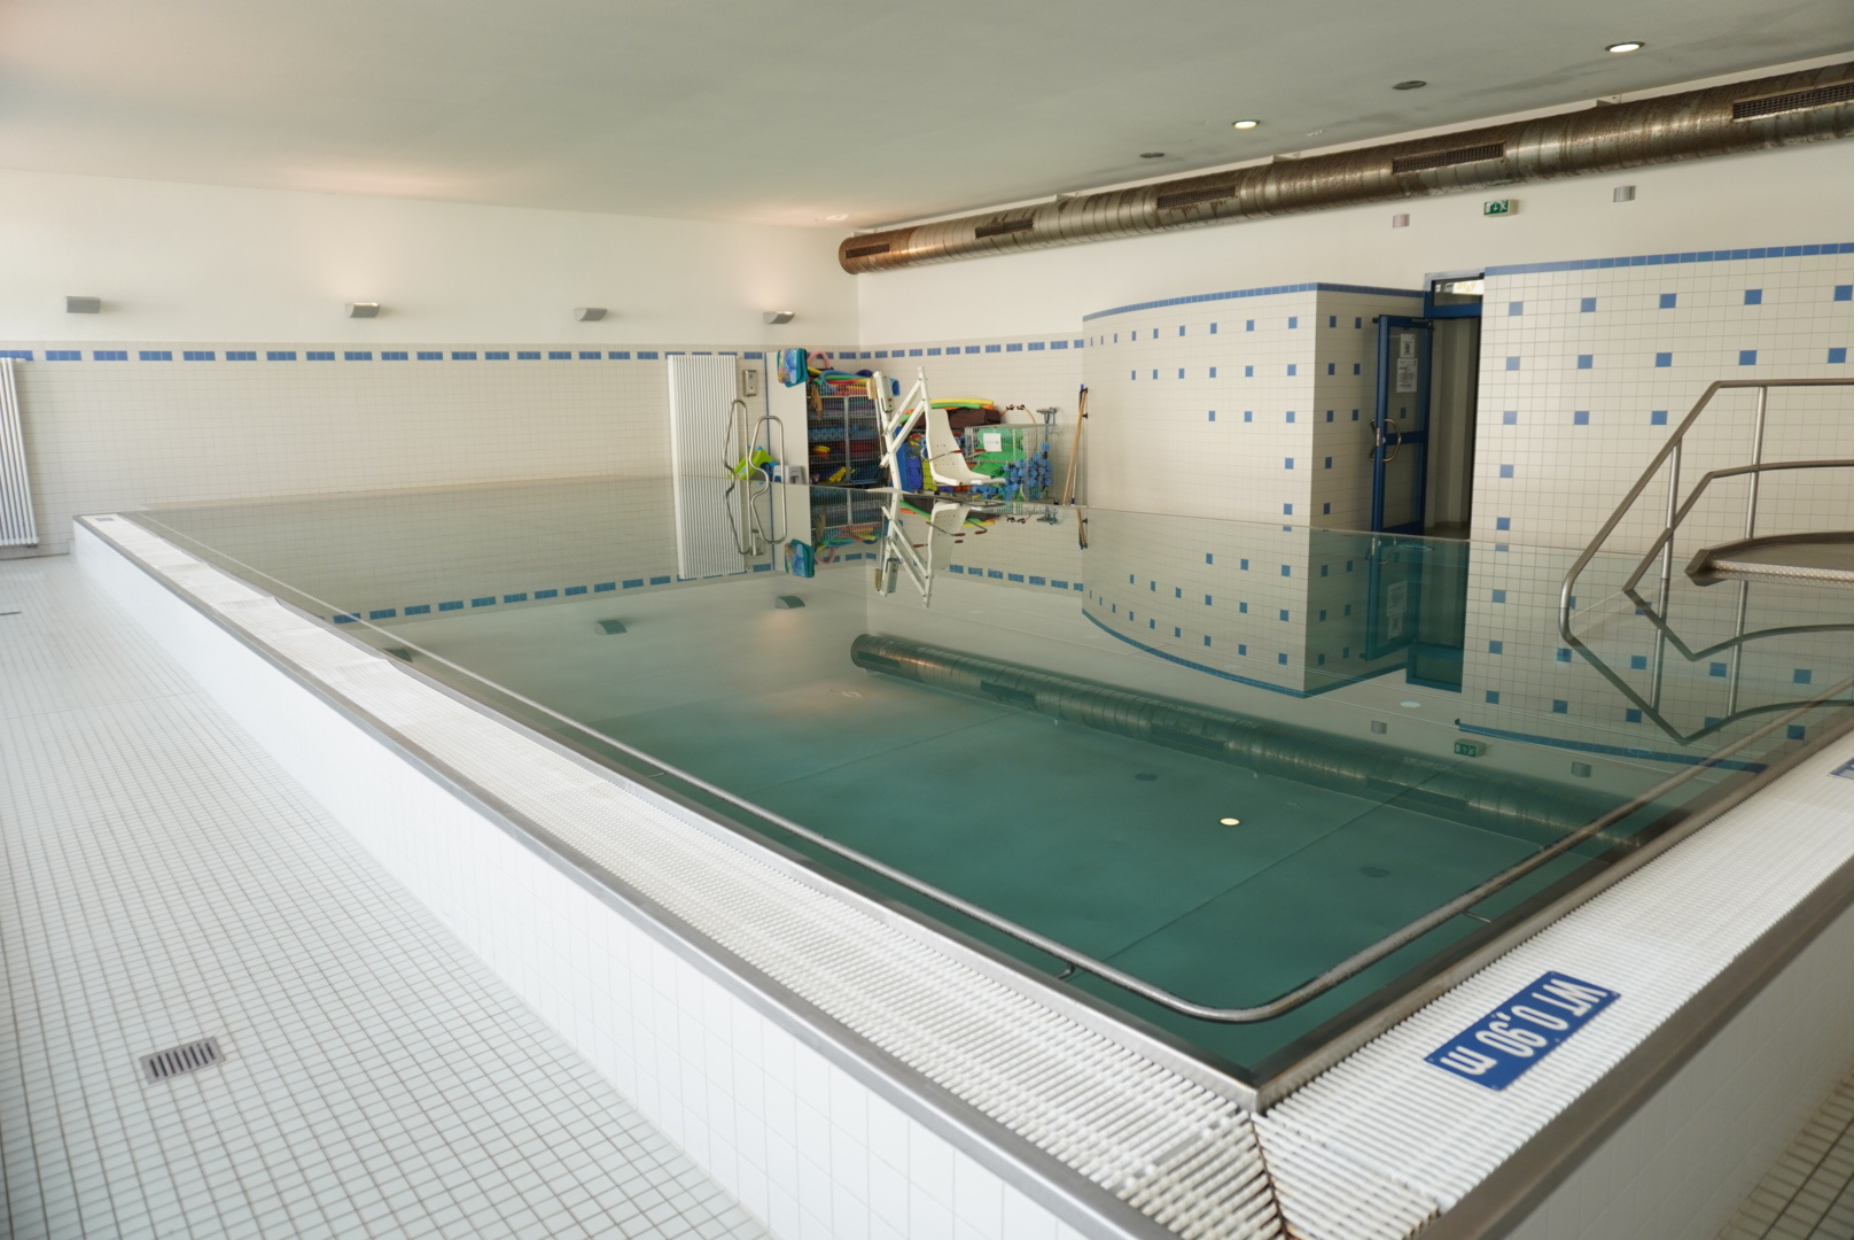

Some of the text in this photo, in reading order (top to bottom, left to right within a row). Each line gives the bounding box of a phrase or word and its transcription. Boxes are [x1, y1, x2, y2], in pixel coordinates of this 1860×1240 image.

[1440, 978, 1608, 1075] WT 0,90 m
